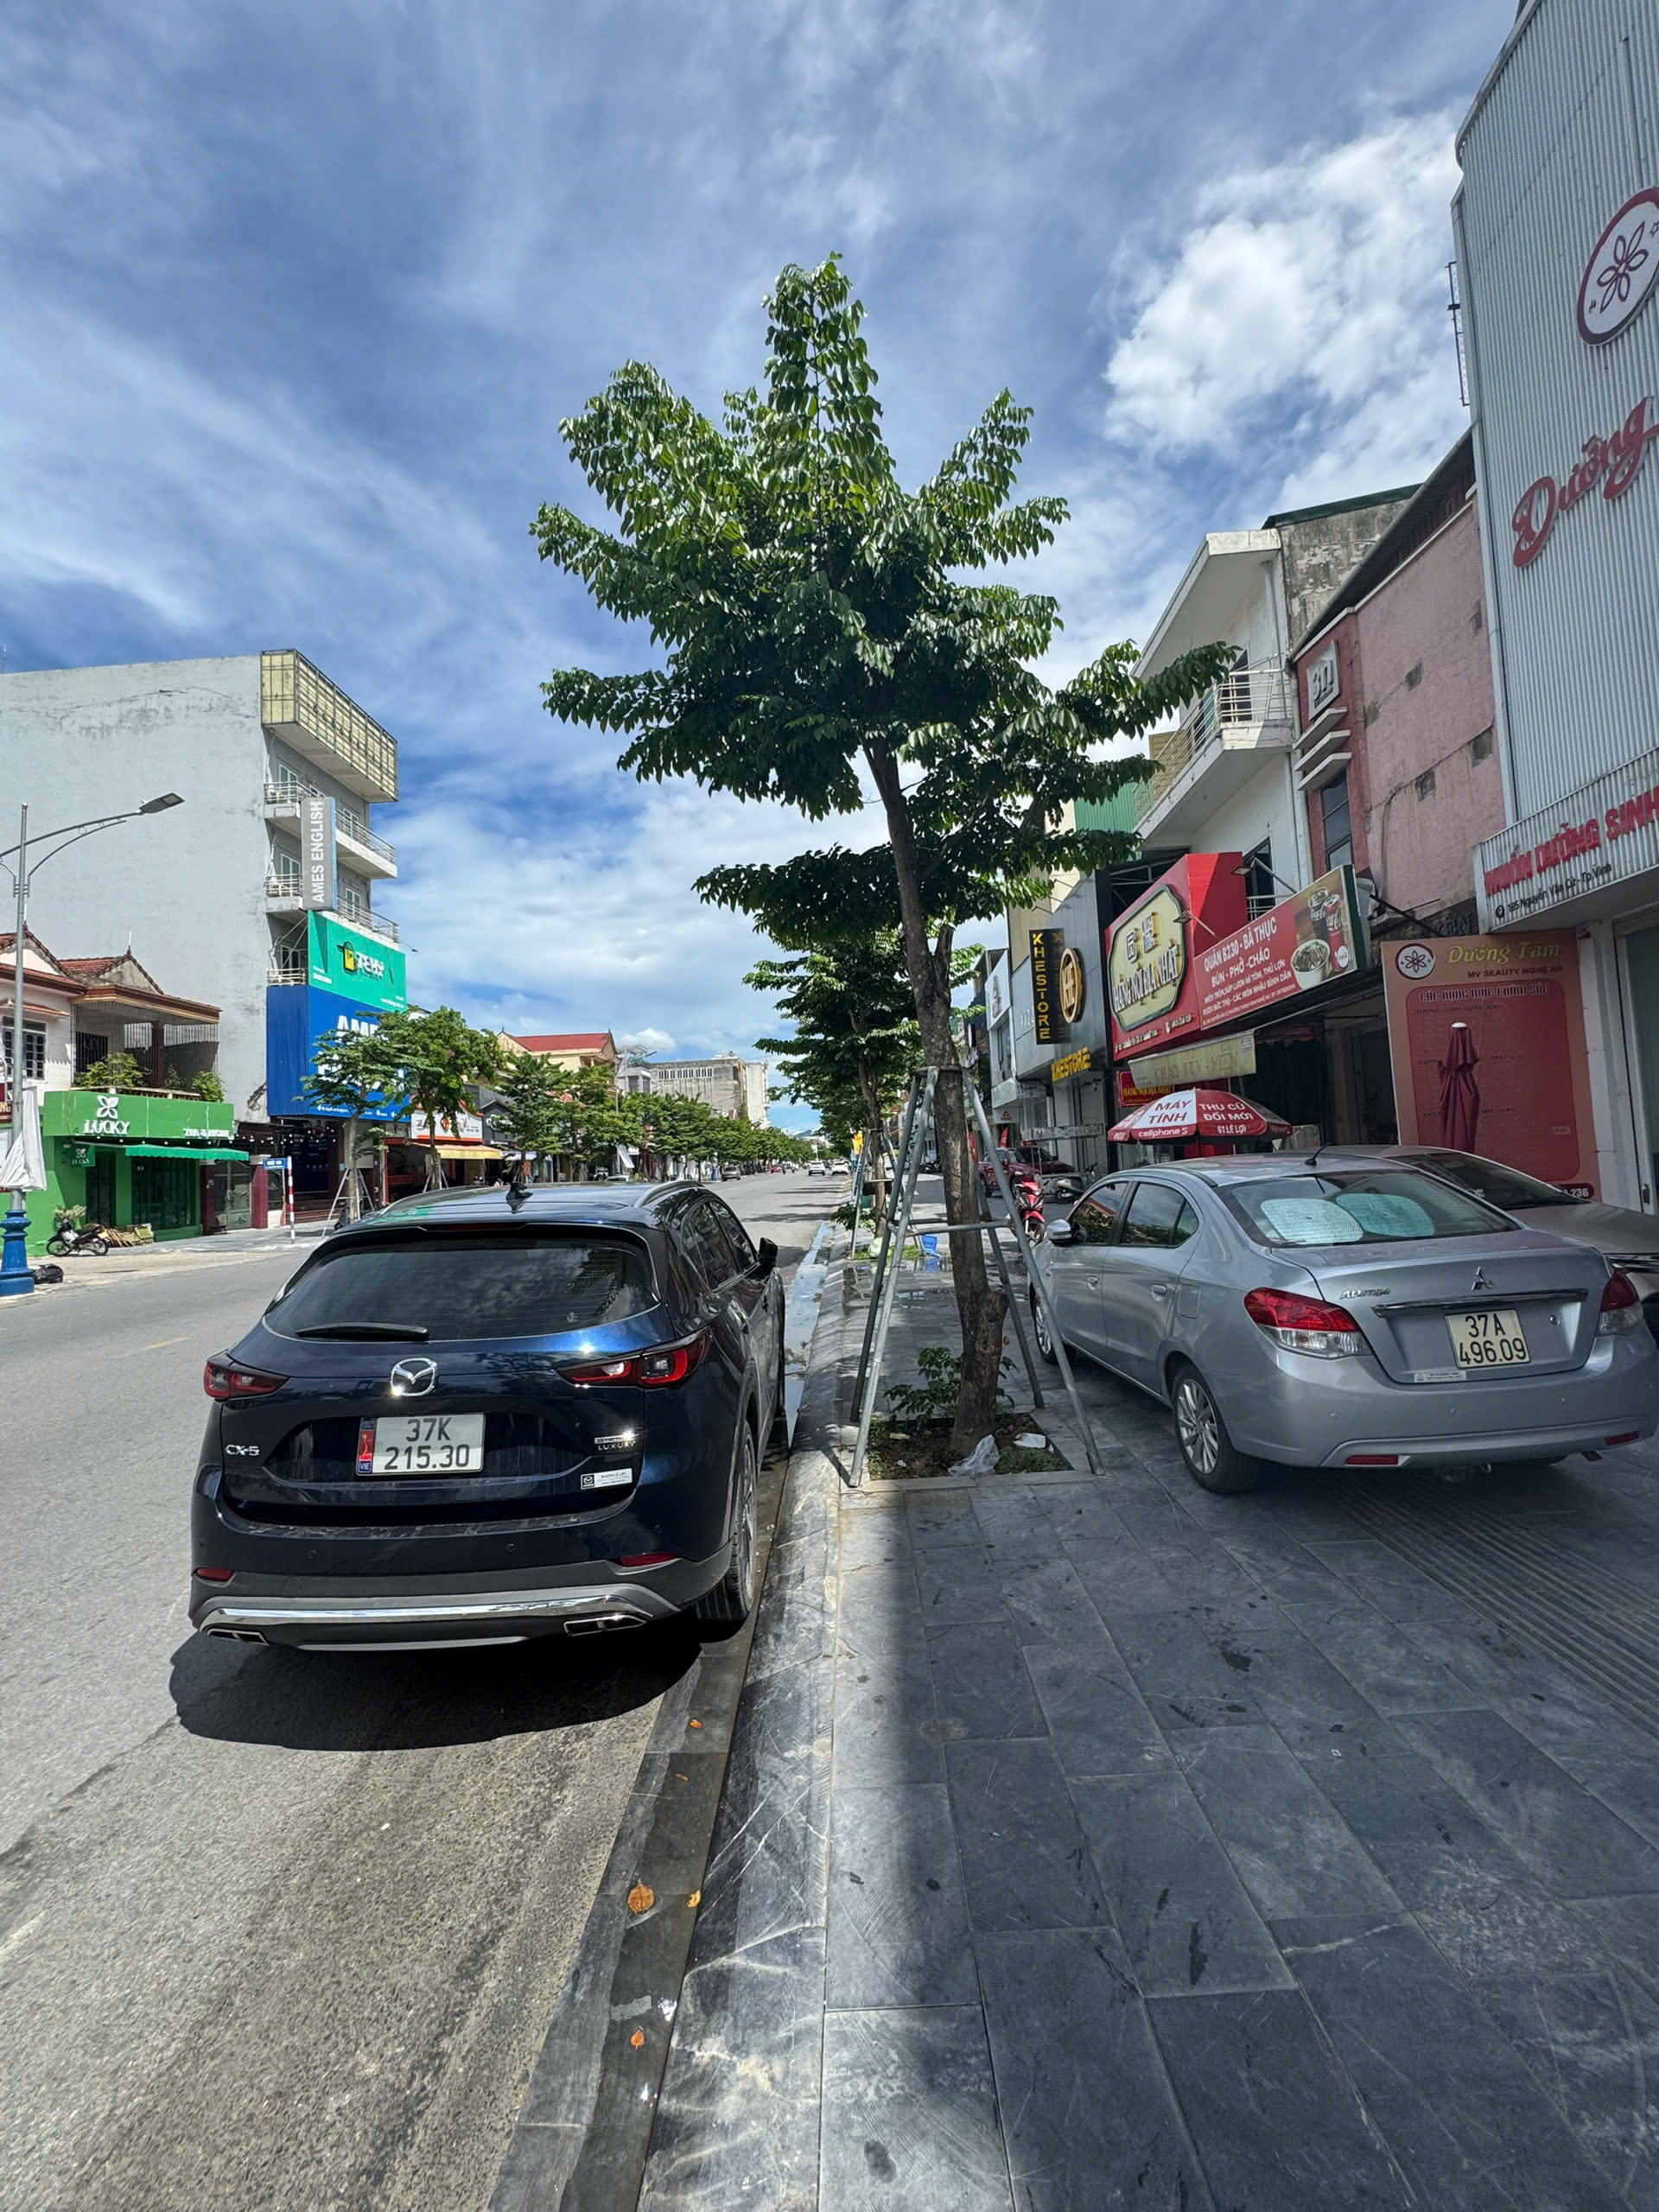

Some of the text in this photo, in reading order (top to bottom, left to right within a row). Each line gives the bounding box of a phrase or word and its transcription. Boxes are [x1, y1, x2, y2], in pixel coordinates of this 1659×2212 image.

[1535, 818, 1601, 875] DƯỠNG
[1605, 785, 1659, 842] SINH
[309, 801, 325, 903] AMES ENGLISH
[1520, 887, 1548, 909] Nguyễn
[1204, 917, 1277, 972] QUÁN B230 BÀ THỤC
[1446, 943, 1512, 965] Dưỡng
[1211, 969, 1225, 988] BÚN
[1230, 957, 1245, 978] PHỞ
[1483, 968, 1520, 977] BEAUTY
[1550, 965, 1563, 974] AN
[1032, 932, 1052, 1040] KHESTORE
[1051, 1046, 1091, 1083] KHESTORE
[1154, 1099, 1192, 1111] MÁY
[1203, 1110, 1255, 1122] ĐỔI MỚI
[1227, 1101, 1246, 1111] CŨ
[83, 1119, 130, 1135] LUCKY
[1148, 1112, 1188, 1124] TÍNH
[1138, 1128, 1180, 1139] cellphone
[1225, 1124, 1234, 1135] LÊ
[1235, 1124, 1247, 1135] LỢI
[1570, 1187, 1589, 1198] 236
[1465, 1313, 1506, 1338] 37A
[1459, 1337, 1527, 1365] 496.09
[405, 1417, 454, 1442] 37K
[225, 1444, 260, 1457] CX-5
[598, 1440, 636, 1451] LUXURY
[384, 1444, 470, 1470] 215.30
